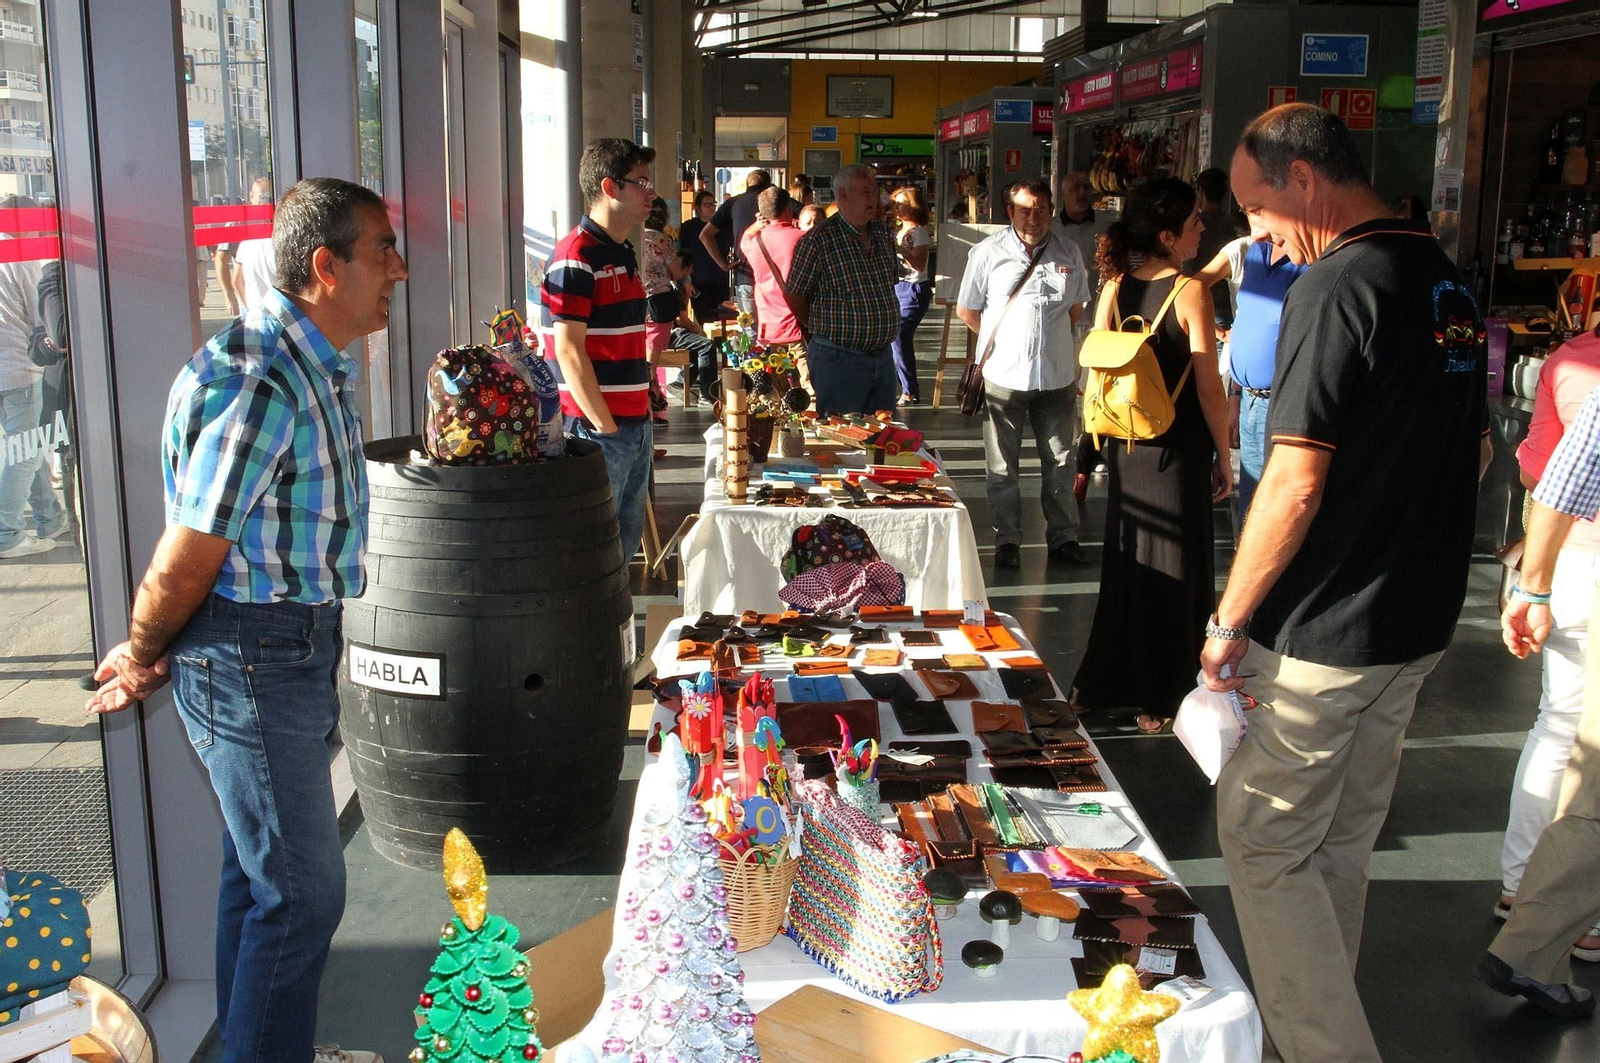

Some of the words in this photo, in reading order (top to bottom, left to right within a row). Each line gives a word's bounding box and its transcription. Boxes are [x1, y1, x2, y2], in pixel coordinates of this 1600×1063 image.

[1305, 51, 1338, 62] COMINO
[19, 157, 33, 172] DE
[33, 157, 53, 173] LAS
[357, 656, 429, 687] HABLA
